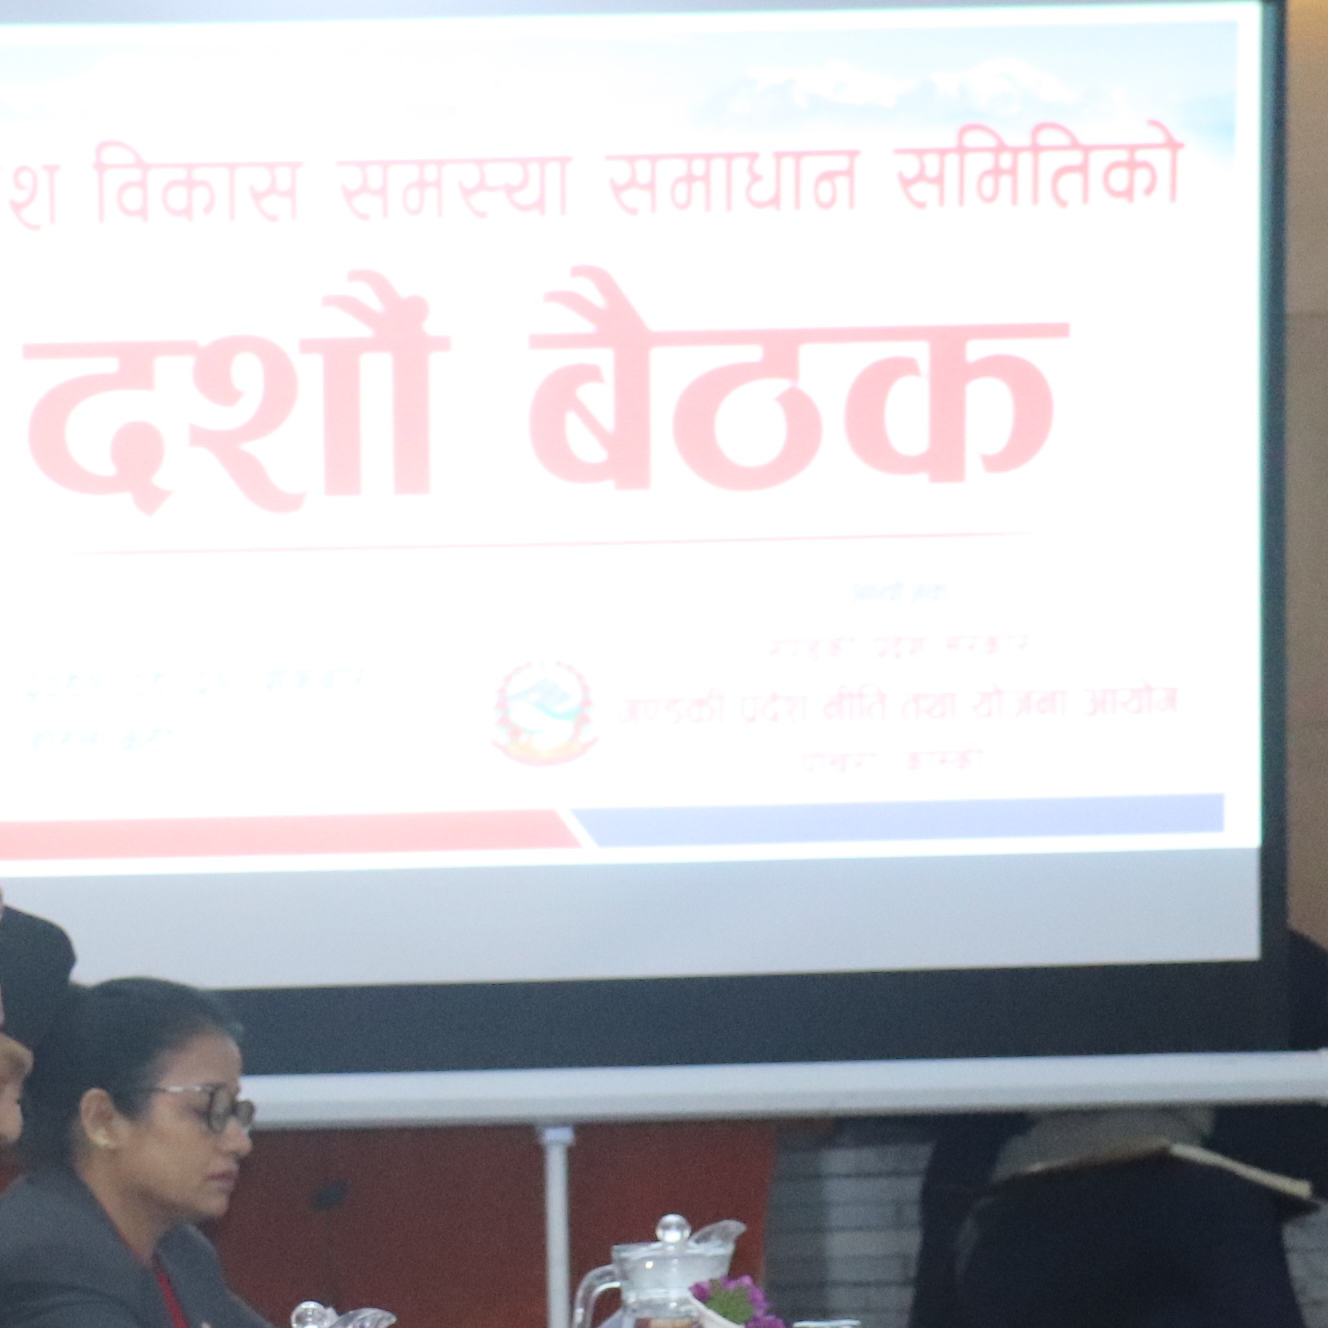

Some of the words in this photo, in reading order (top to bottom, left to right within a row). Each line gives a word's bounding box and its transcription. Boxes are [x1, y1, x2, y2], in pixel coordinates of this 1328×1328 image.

[92, 139, 304, 225] विकास
[337, 155, 573, 222] समस्या
[605, 148, 862, 217] समाधान
[894, 118, 1186, 210] समितिको
[528, 264, 1071, 492] बैठक
